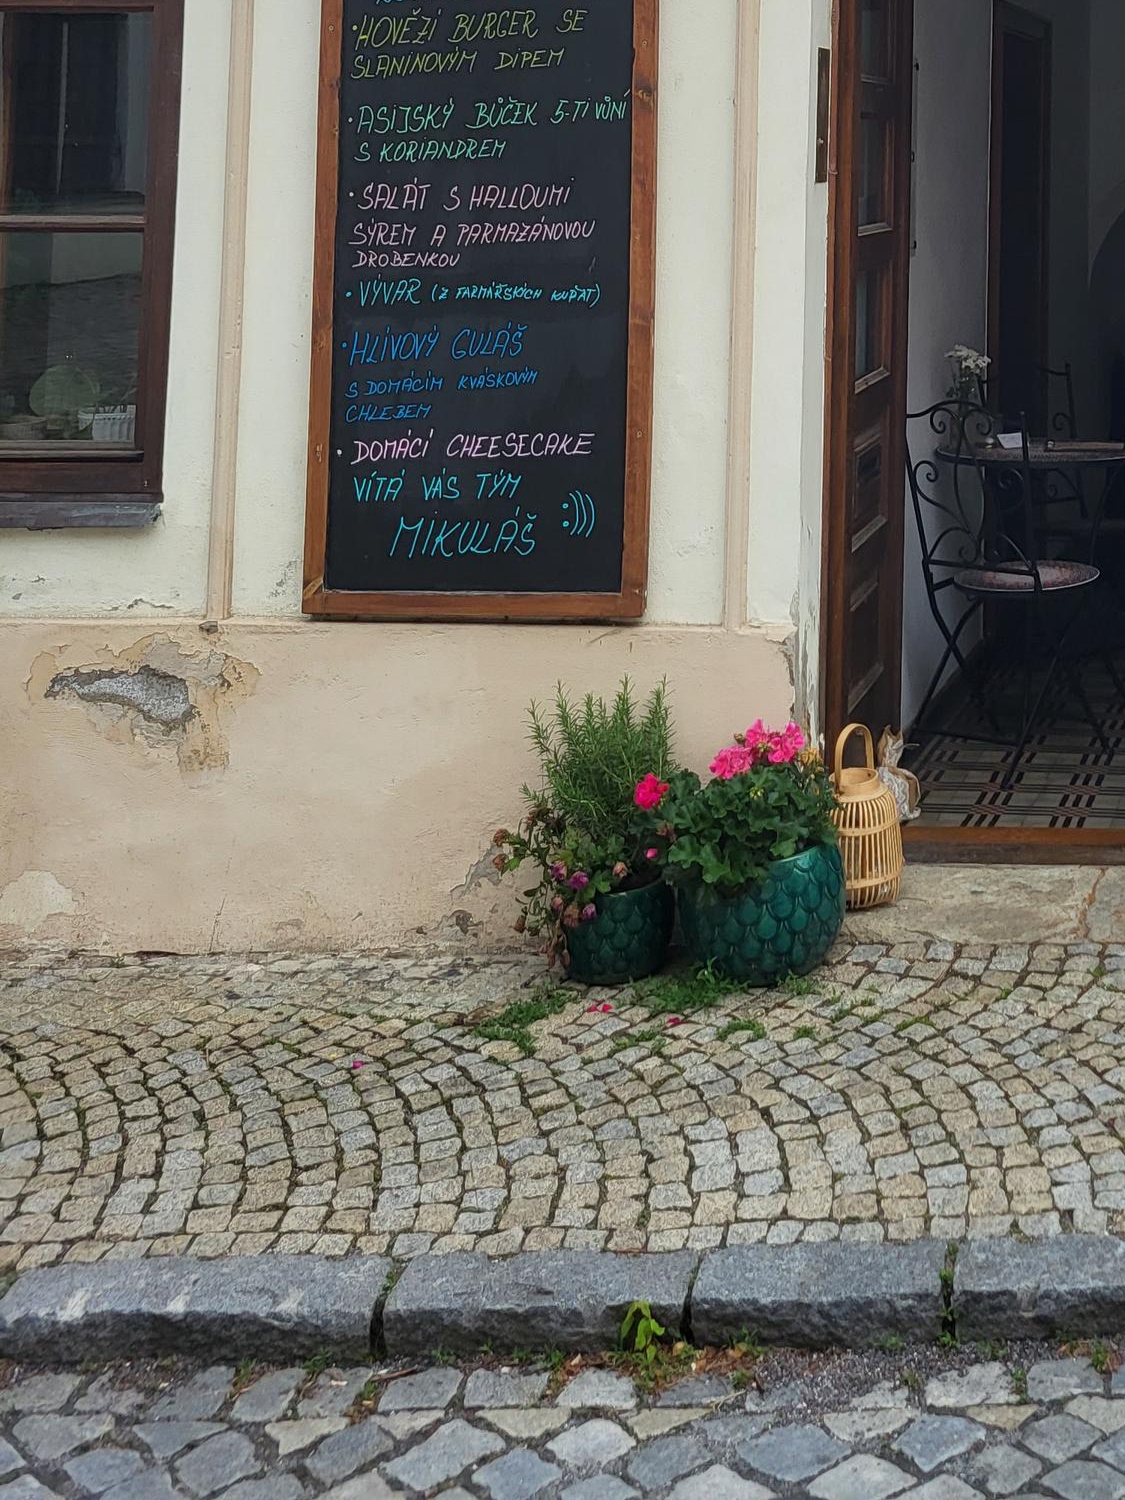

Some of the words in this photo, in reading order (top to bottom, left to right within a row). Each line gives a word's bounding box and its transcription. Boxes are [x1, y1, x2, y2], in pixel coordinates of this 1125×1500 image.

[448, 10, 538, 44] BURGER
[556, 10, 588, 32] SE
[351, 46, 477, 80] SLANINOVÝM
[494, 48, 564, 70] DIPEM
[465, 97, 538, 129] BŮČEK
[354, 143, 370, 162] S
[379, 137, 507, 162] KORIANDREM
[443, 186, 461, 211] S
[469, 177, 576, 211] HALLOUMI
[349, 218, 417, 246] SÝREM
[430, 225, 447, 247] A
[456, 216, 596, 244] PARMAZÁNOVOU
[352, 250, 461, 268] DROBENKOU
[452, 321, 529, 359] GULÁŠ
[345, 381, 358, 398] S
[365, 369, 444, 395] DOMÁCÍM
[457, 366, 539, 390] KVÁSKOVÝM
[345, 404, 433, 423] CHLEBEM
[446, 433, 596, 458] CHEESECAKE
[353, 469, 405, 502] VÍTÁ
[422, 467, 461, 500] VÁS
[476, 469, 522, 499] TÝM
[389, 506, 538, 559] MIKULÁŠ
